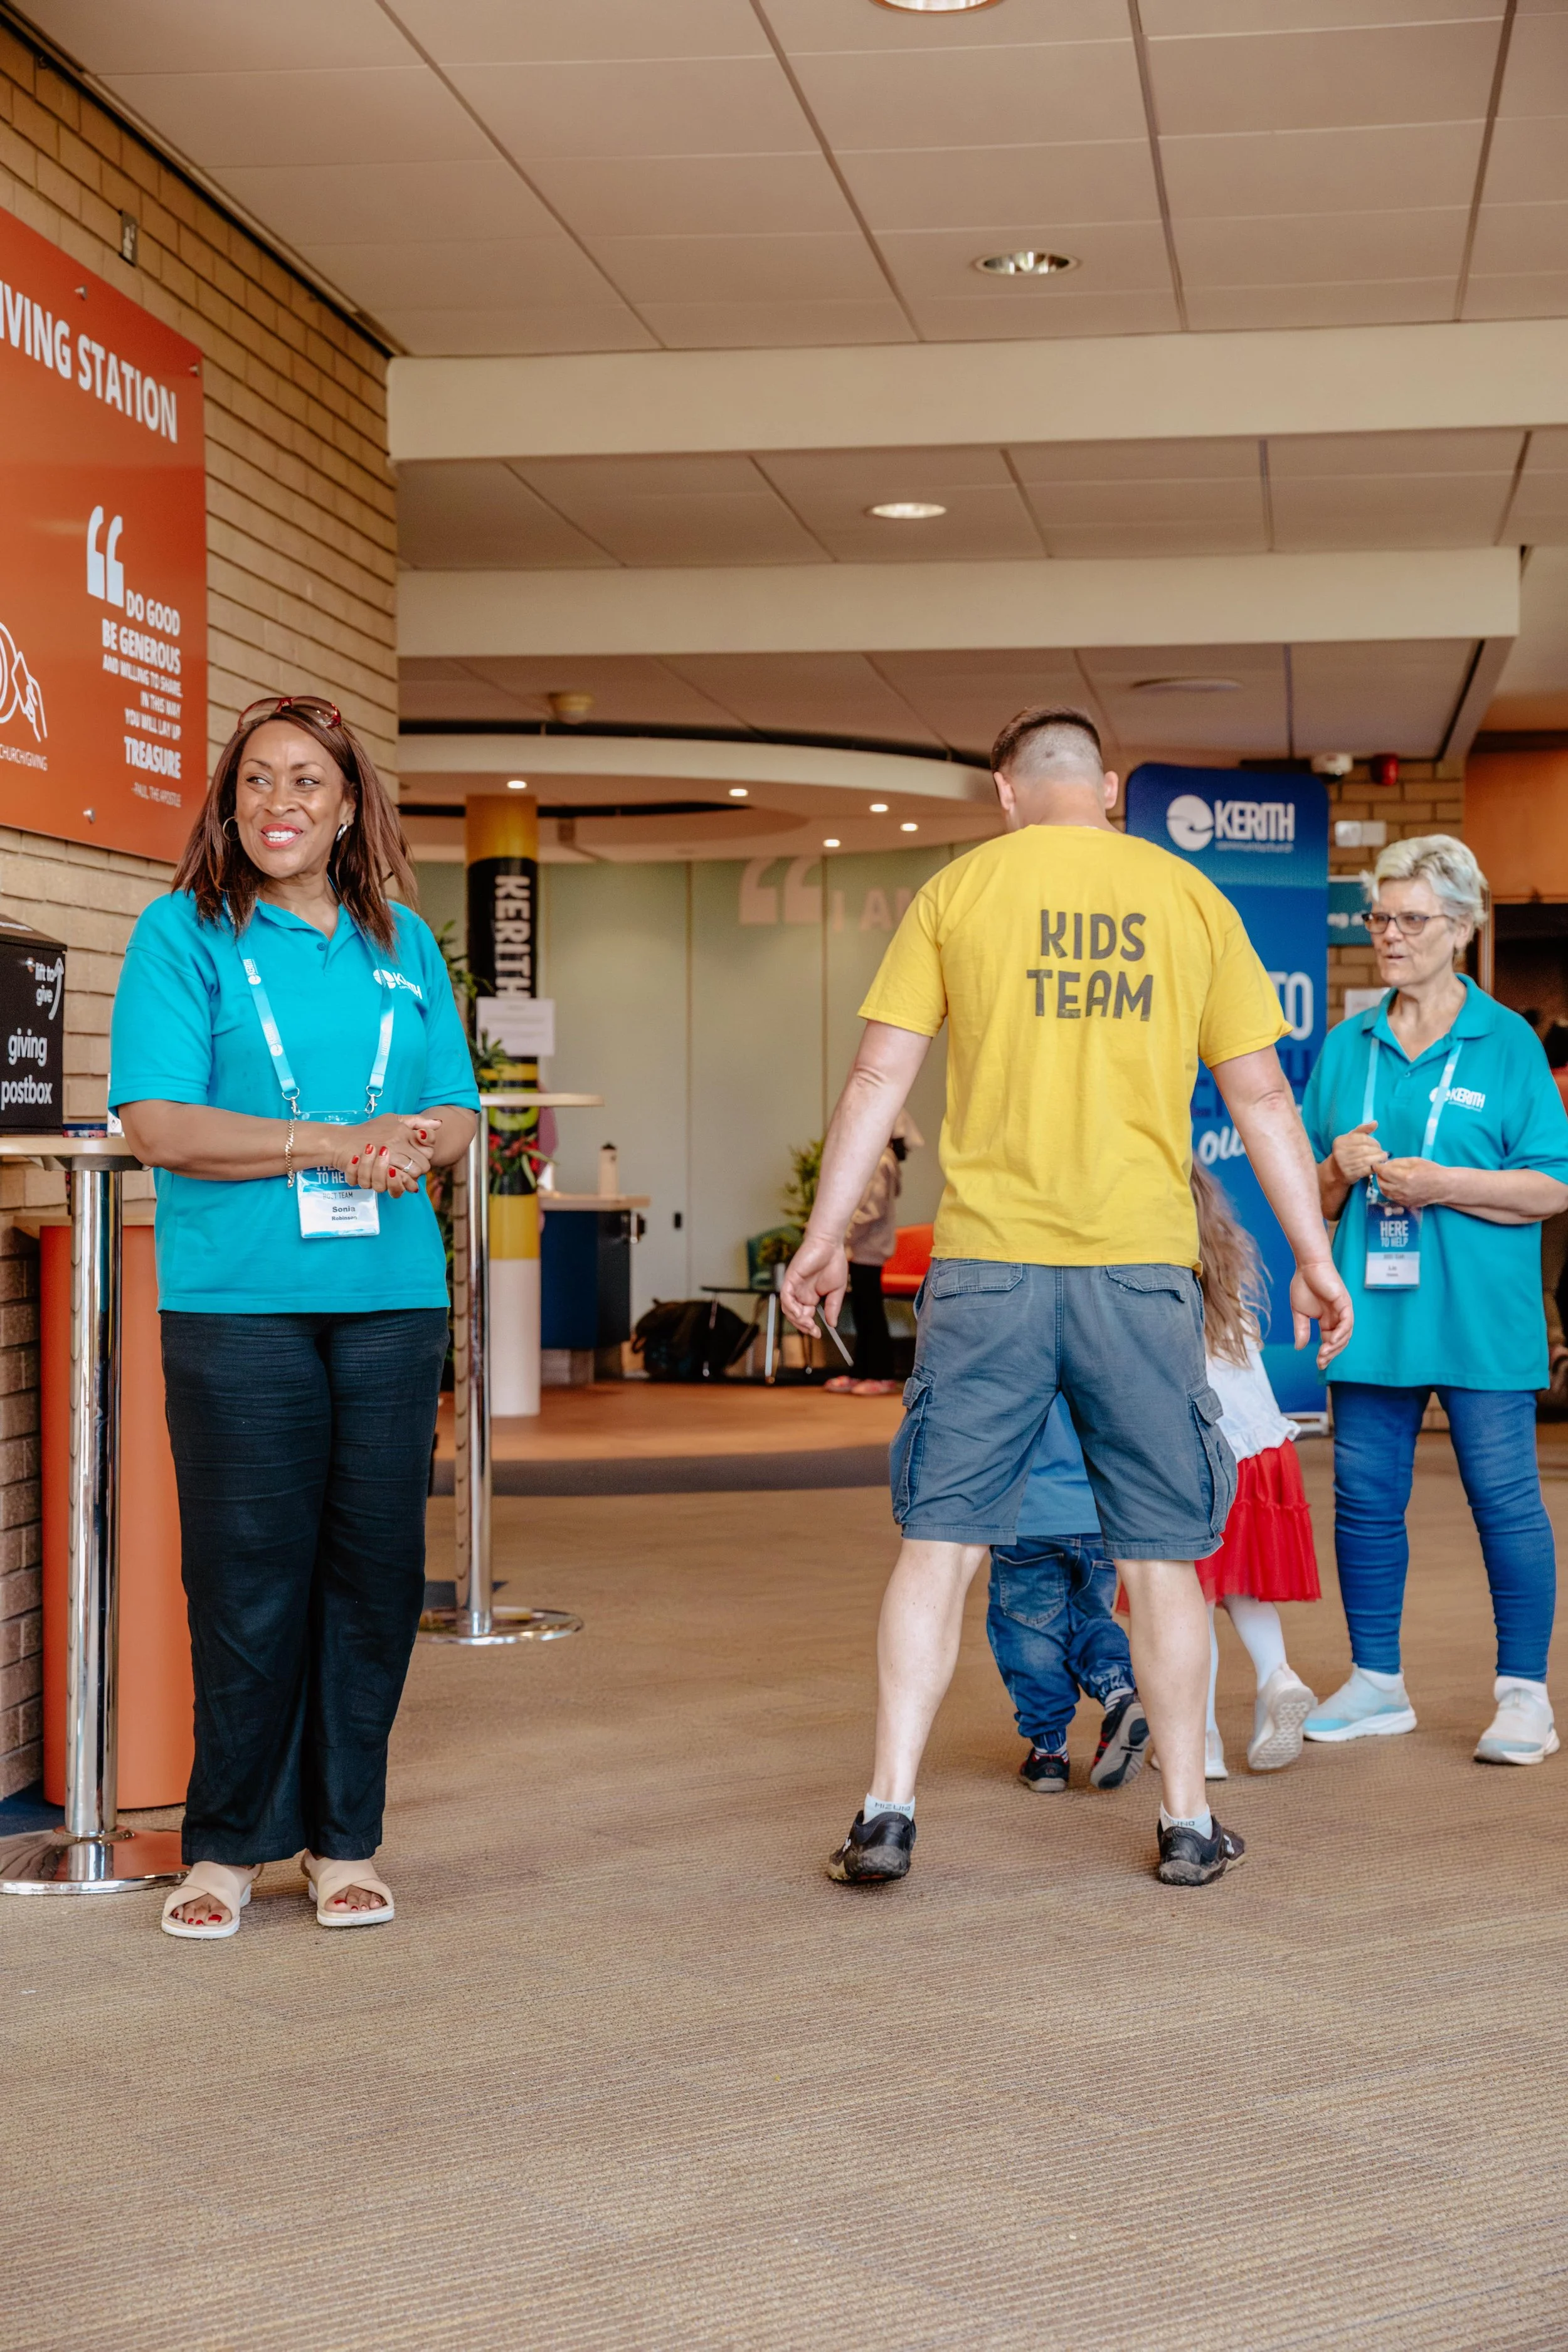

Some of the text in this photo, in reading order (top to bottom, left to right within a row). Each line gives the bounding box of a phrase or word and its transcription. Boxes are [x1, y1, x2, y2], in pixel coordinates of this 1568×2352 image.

[78, 334, 177, 443] STATION
[126, 589, 181, 637] DO GOOD
[102, 618, 181, 675] BE GENEROUS
[102, 654, 119, 674] AND
[120, 660, 149, 686] WILLING
[150, 670, 160, 689] TO
[140, 691, 181, 719] IN THIS WAY
[125, 707, 139, 728] YOU
[140, 714, 157, 734] WILL
[171, 725, 181, 741] UP
[124, 736, 181, 779] TREASURE
[1214, 800, 1295, 842] KERITH
[494, 875, 531, 997] KERITH
[1040, 909, 1147, 961] KIDS
[36, 985, 53, 1007] give
[1026, 969, 1153, 1022] TEAM
[8, 1027, 48, 1066] giving
[1, 1074, 53, 1111] postbox
[1450, 1087, 1486, 1109] KERITH
[316, 1172, 329, 1184] TO
[338, 1191, 353, 1199] TEAM
[1380, 1220, 1409, 1237] HERE
[1381, 1236, 1408, 1248] TO HELP
